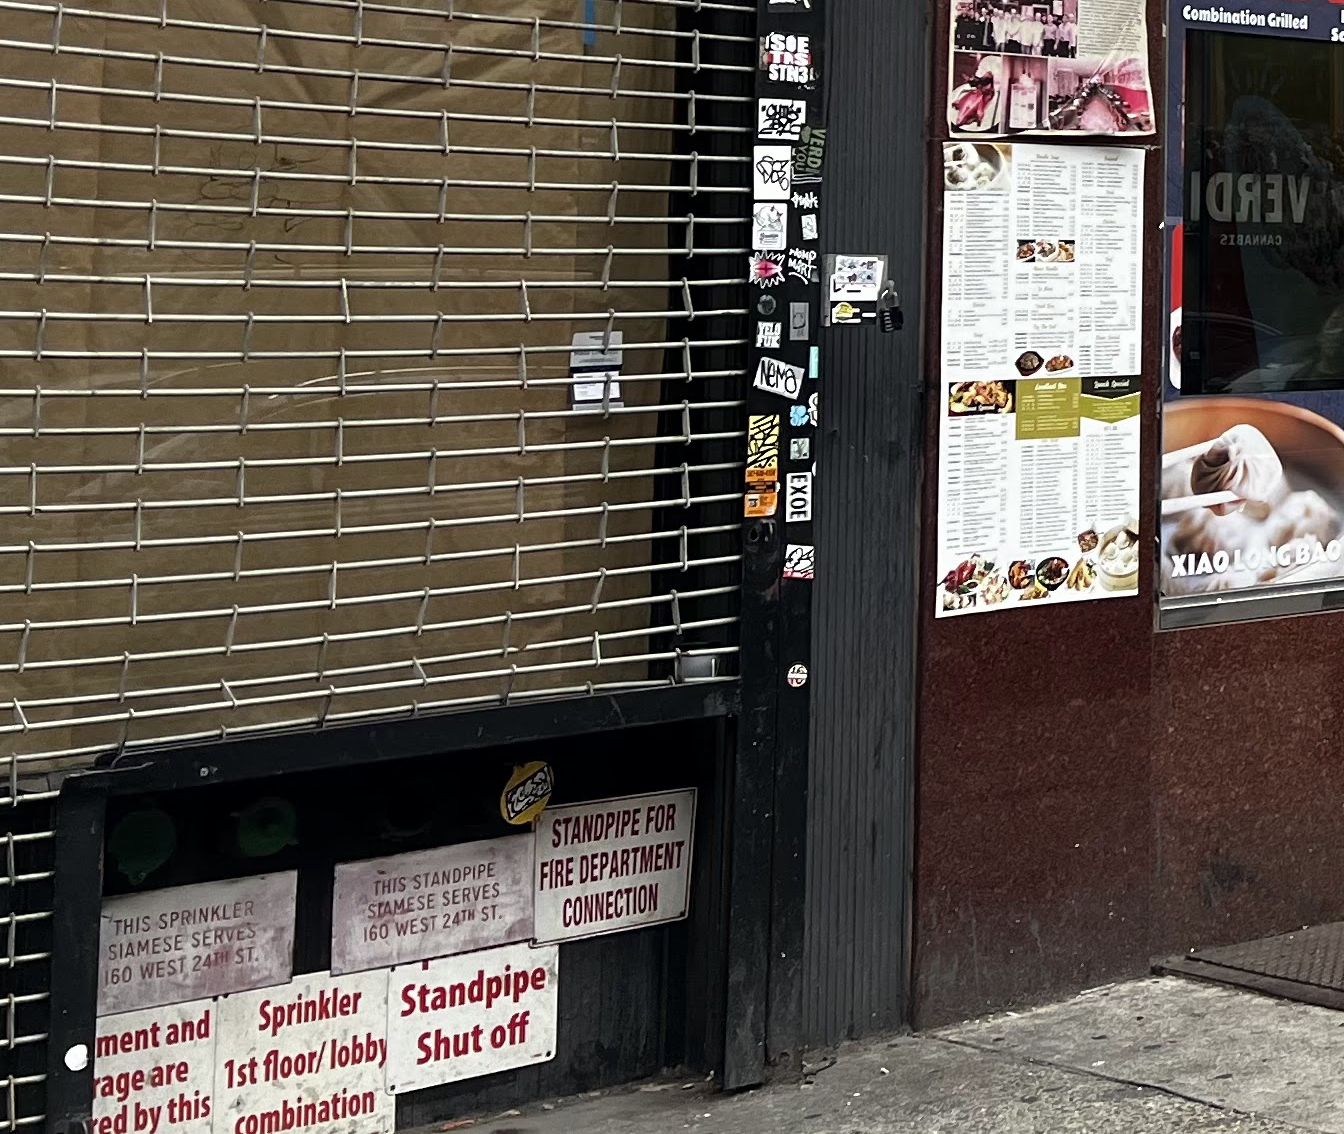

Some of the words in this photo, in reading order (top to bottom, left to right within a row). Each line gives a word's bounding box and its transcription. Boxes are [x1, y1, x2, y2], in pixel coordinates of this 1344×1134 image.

[1183, 5, 1265, 27] Combination
[1267, 13, 1308, 29] Grilled
[1171, 550, 1230, 578] XIAO
[1233, 544, 1291, 571] LONG
[1295, 539, 1342, 566] BAO
[551, 808, 640, 848] STANDPIPE
[644, 803, 677, 834] FOR
[373, 876, 406, 897] THIS
[413, 862, 496, 890] STANDPIPE
[540, 857, 574, 891] FIRE
[579, 840, 685, 884] DEPARTMENT
[442, 882, 501, 908] SERVES
[562, 882, 659, 928] CONNECTION
[113, 916, 150, 936] THIS
[159, 900, 255, 931] SPRINKLER
[363, 923, 389, 943] 160
[396, 916, 437, 937] WEST
[442, 908, 475, 928] 24TH
[481, 904, 502, 922] ST.
[108, 934, 183, 961] SIAMESE
[191, 925, 256, 949] SERVES
[104, 966, 132, 986] 160
[140, 958, 186, 980] WEST
[192, 950, 229, 973] 24TH
[235, 946, 259, 965] ST.
[401, 964, 547, 1017] Standpipe
[166, 1009, 210, 1046] and
[259, 987, 362, 1037] Sprinkler
[416, 1023, 483, 1065] Shut
[490, 1011, 531, 1050] off
[150, 1060, 189, 1088] are
[224, 1056, 258, 1088] 1st
[263, 1041, 327, 1083] floor/
[330, 1032, 388, 1069] lobby
[133, 1100, 162, 1134] by
[167, 1090, 211, 1125] this
[234, 1087, 375, 1134] combination
